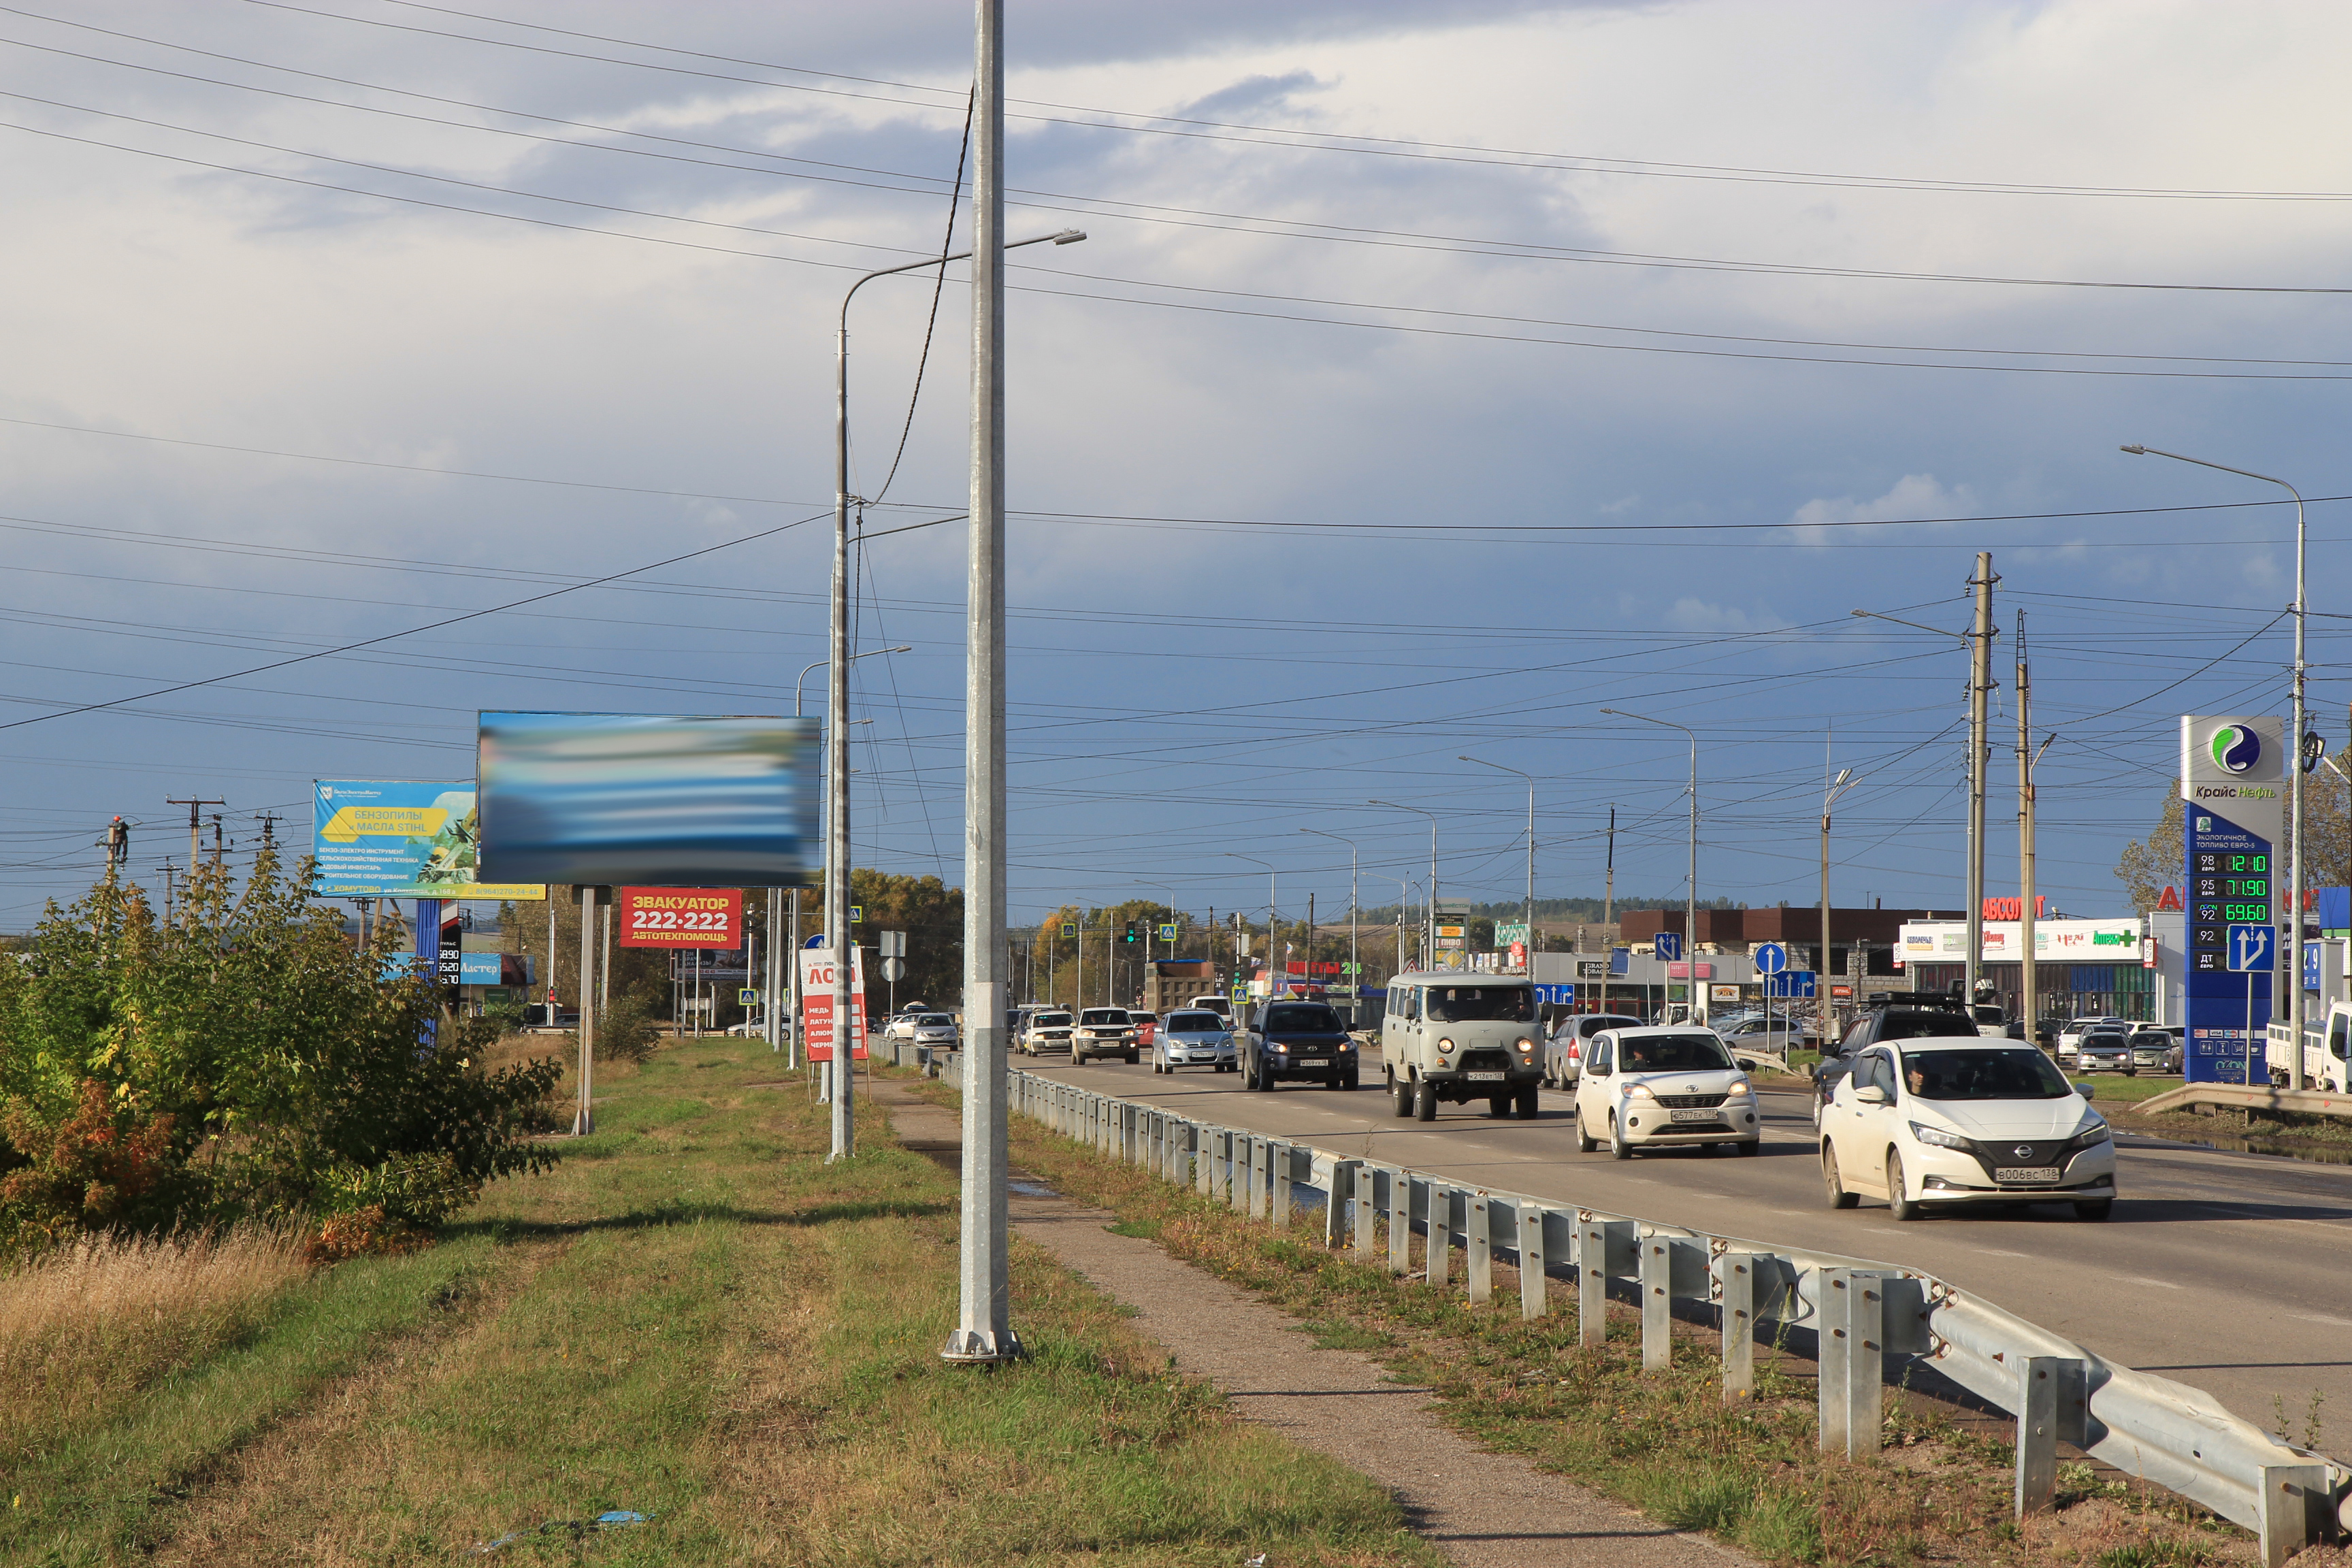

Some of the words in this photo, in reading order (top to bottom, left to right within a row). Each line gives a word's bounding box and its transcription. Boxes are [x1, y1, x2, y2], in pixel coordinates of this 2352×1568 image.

[2195, 786, 2236, 799] Крайс
[2237, 786, 2276, 799] Нефть
[355, 811, 422, 821] БЕНЗОПИЛЫ
[357, 823, 395, 832] МАСЛА
[397, 823, 427, 832] STIHL
[2201, 855, 2215, 866] 98
[2201, 879, 2215, 889] 95
[2227, 880, 2266, 896] 71.90
[632, 896, 729, 910] ЭВАКУАТОР
[1982, 896, 2046, 920] АБСОЛТ
[2202, 910, 2215, 920] 92
[2226, 904, 2266, 920] 69.60
[632, 932, 728, 943] АВТОТЕХПОМОЩЬ
[2093, 931, 2120, 945] Аптека
[2200, 930, 2214, 941] 92
[2201, 954, 2213, 963] ДТ
[2313, 948, 2318, 970] 9
[1288, 962, 1340, 975] ЦВЕТЫ
[1341, 962, 1362, 975] 24
[1999, 1169, 2039, 1179] В006ВС
[2041, 1169, 2056, 1177] 138
